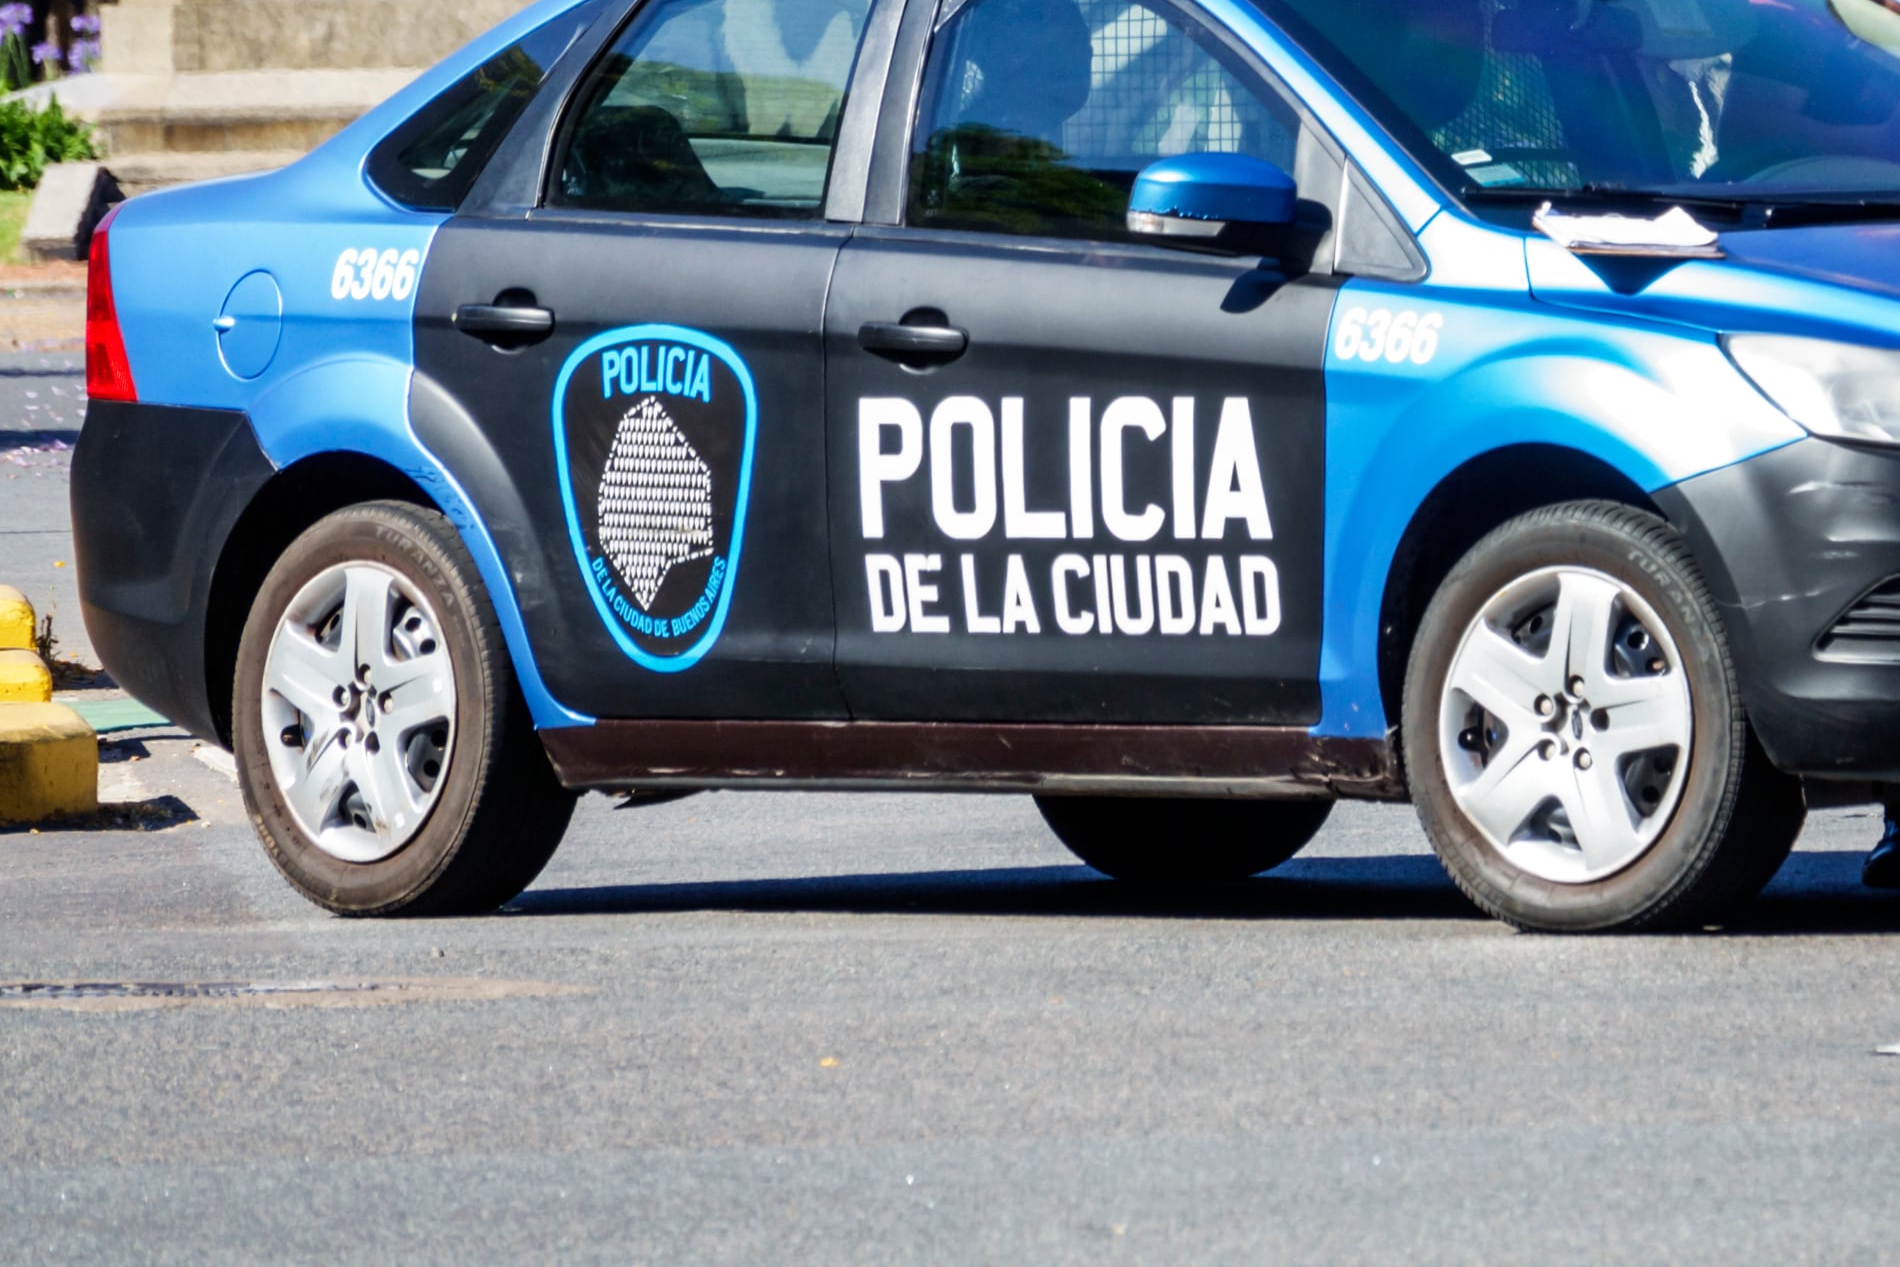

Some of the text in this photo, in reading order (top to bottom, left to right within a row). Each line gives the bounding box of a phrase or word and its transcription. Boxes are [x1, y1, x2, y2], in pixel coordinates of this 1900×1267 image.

[330, 247, 420, 301] 6366
[602, 344, 710, 403] POLICIA
[1334, 306, 1444, 365] 6366
[858, 395, 1273, 542] POLICIA
[375, 525, 456, 609] TURANZA
[592, 556, 726, 638] DE LA CIUDAD DE BUENOS AIRES
[865, 554, 1282, 636] DE LA CIUDAD
